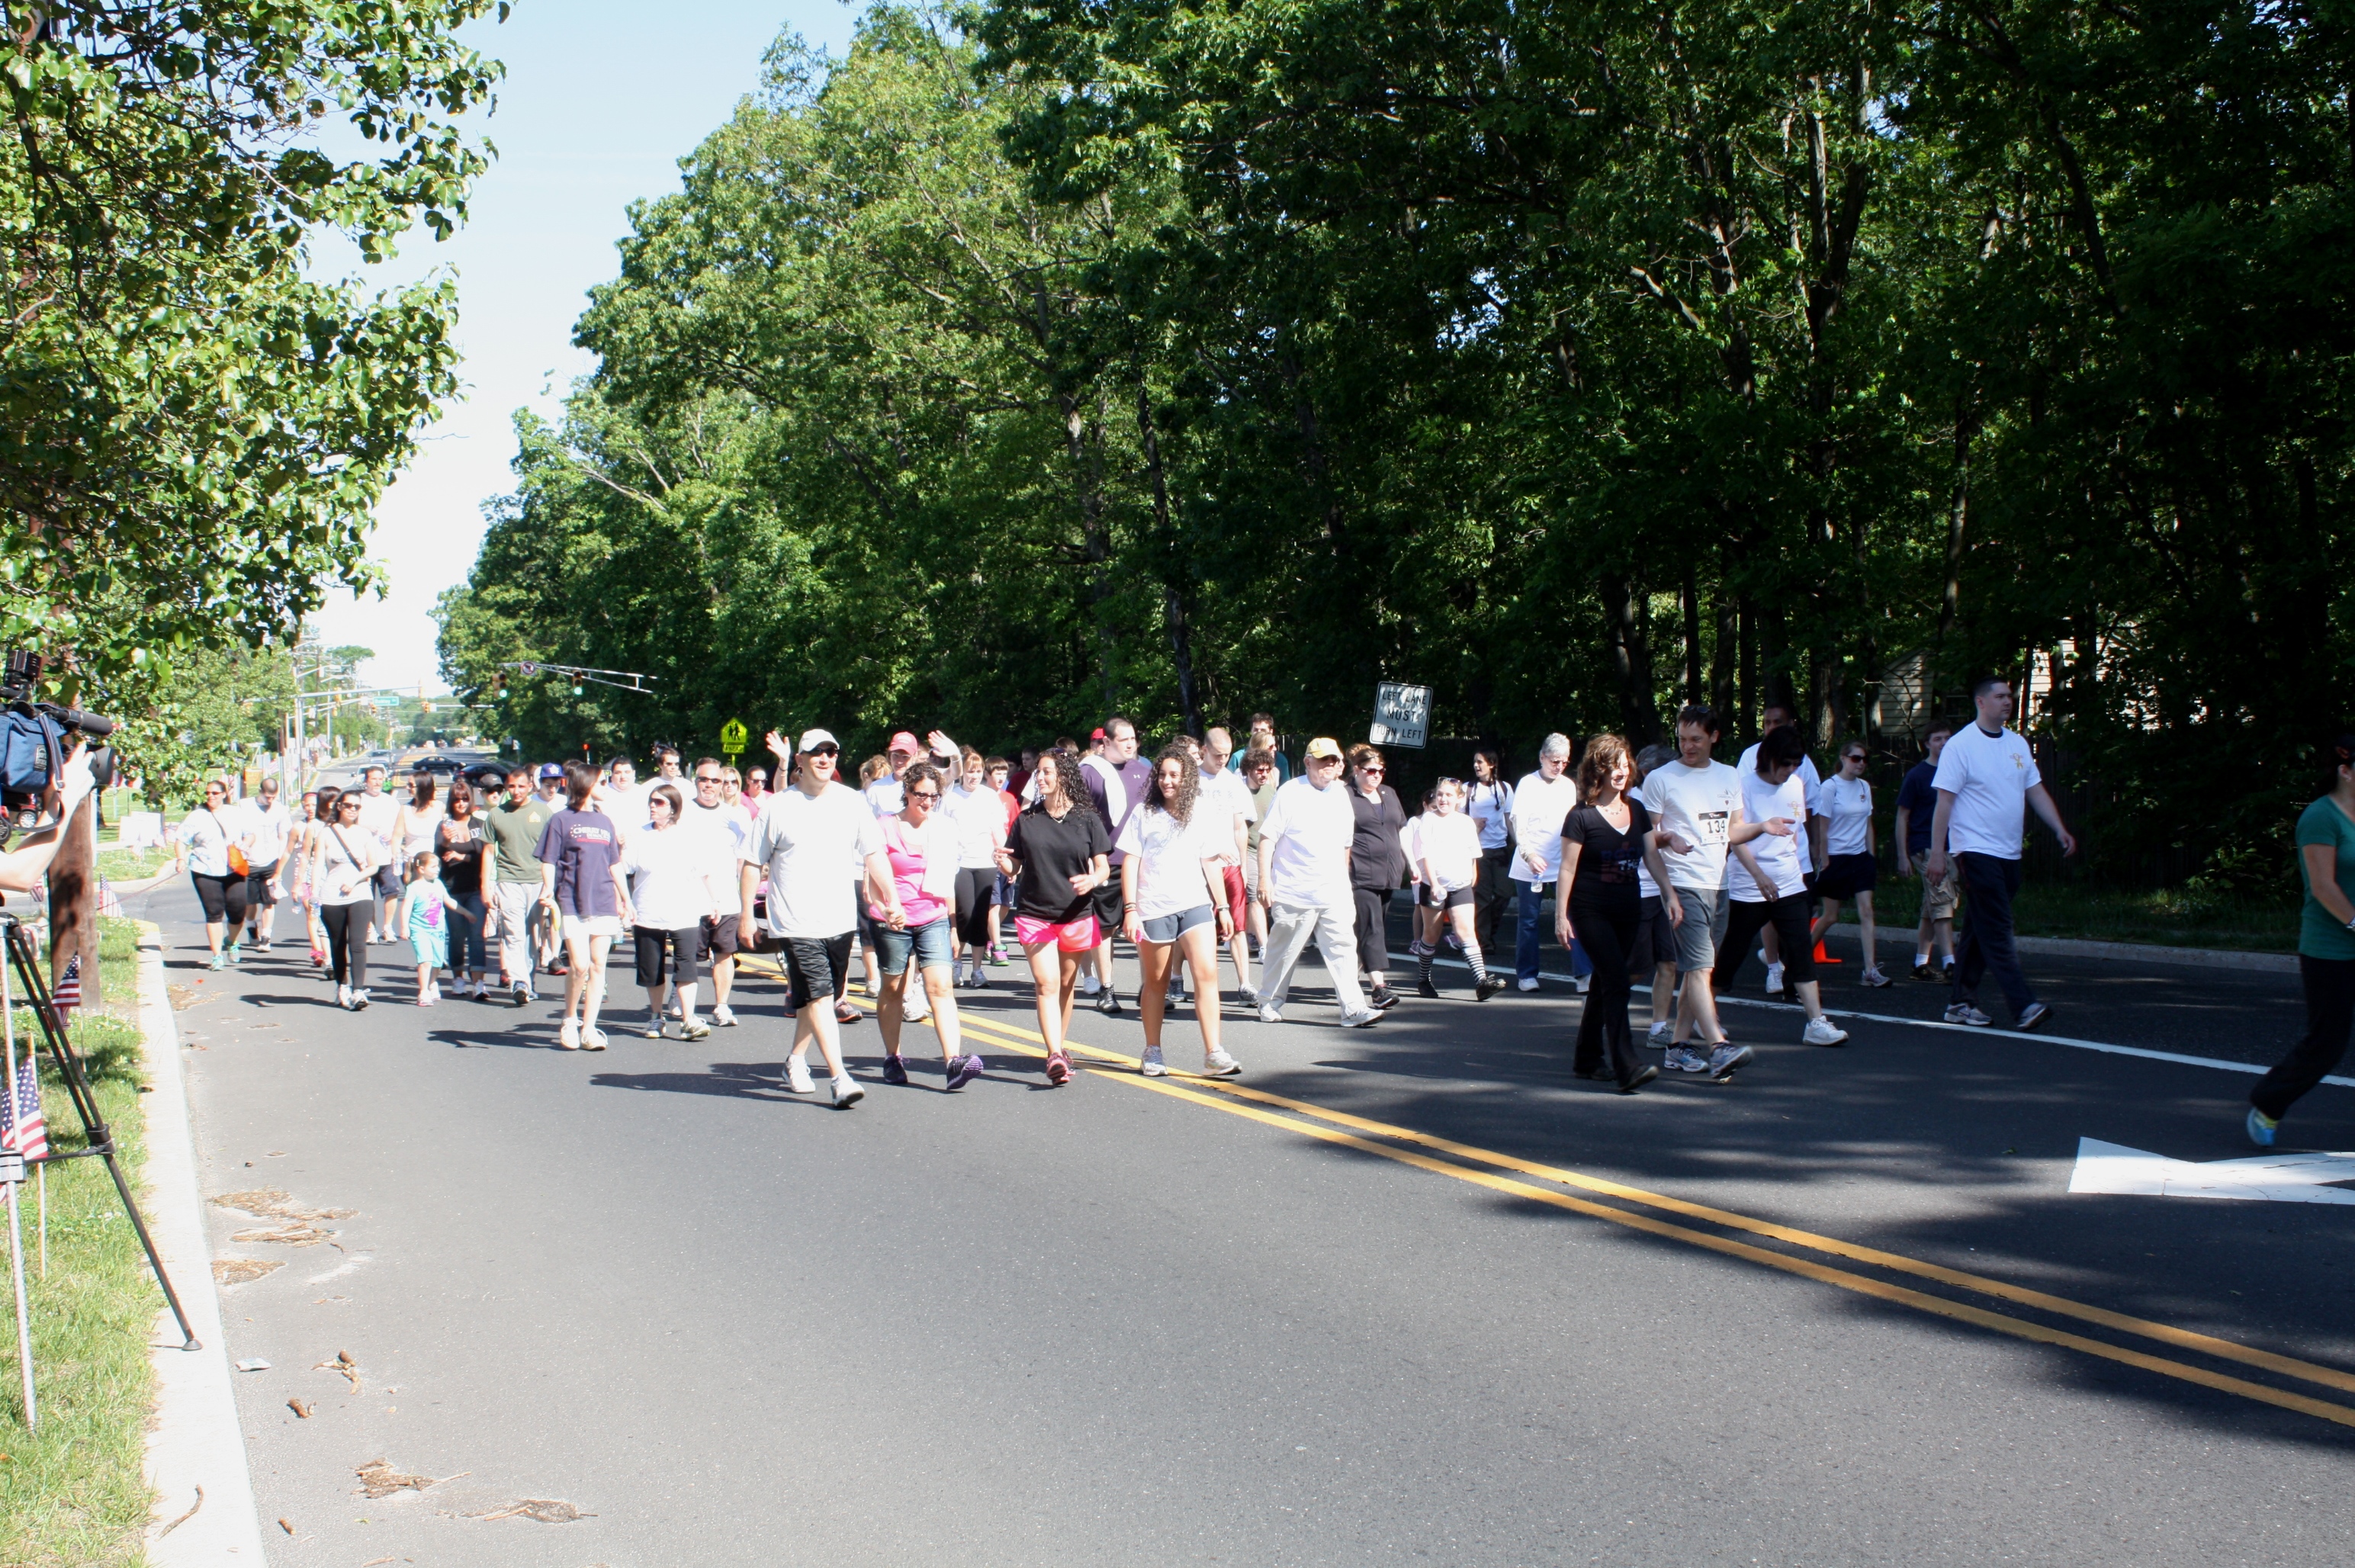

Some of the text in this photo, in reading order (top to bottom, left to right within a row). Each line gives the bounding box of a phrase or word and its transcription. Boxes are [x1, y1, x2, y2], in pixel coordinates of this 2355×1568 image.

[1383, 691, 1427, 705] LEFT LANE
[1386, 708, 1416, 722] MUST
[1376, 725, 1422, 740] TURN LEFT
[1708, 819, 1725, 834] 134
